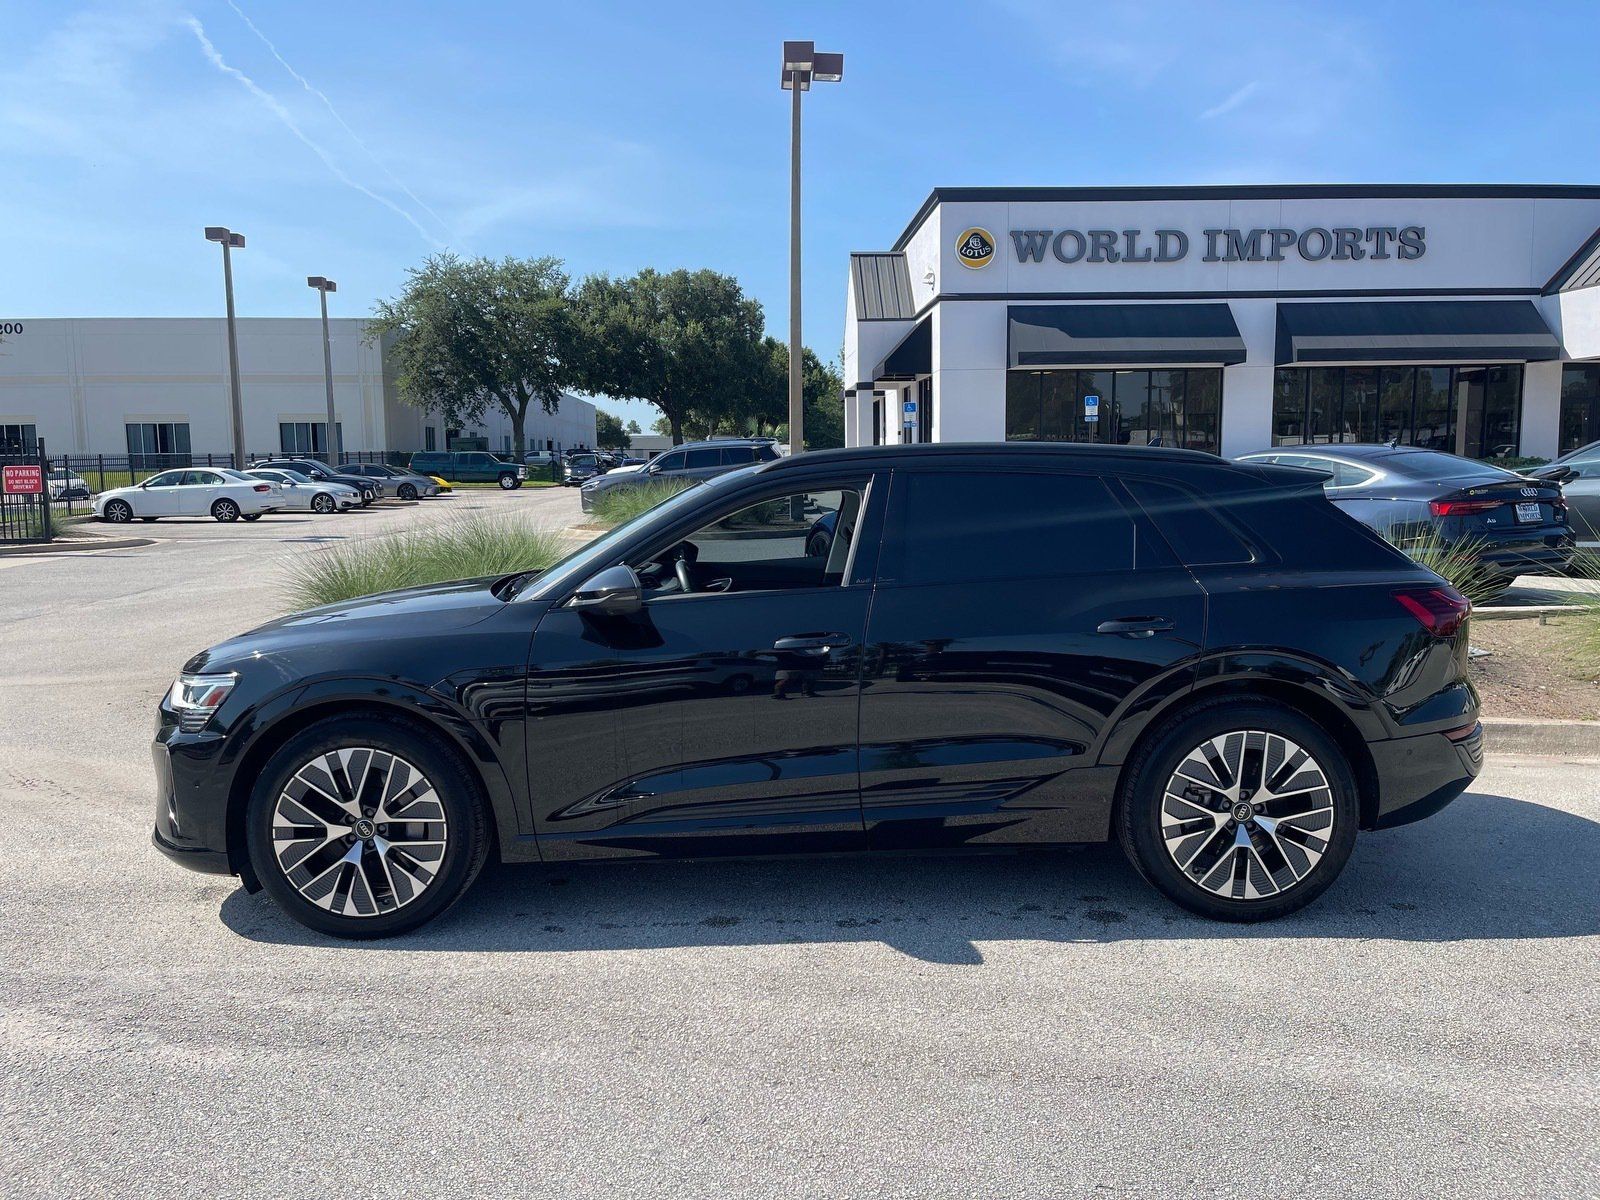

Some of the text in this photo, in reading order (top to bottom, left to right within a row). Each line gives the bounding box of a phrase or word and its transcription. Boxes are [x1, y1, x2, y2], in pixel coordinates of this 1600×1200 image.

[1009, 226, 1426, 264] WORLD IMPORTS
[961, 246, 991, 256] LOTUS
[6, 469, 39, 477] NO PARKING
